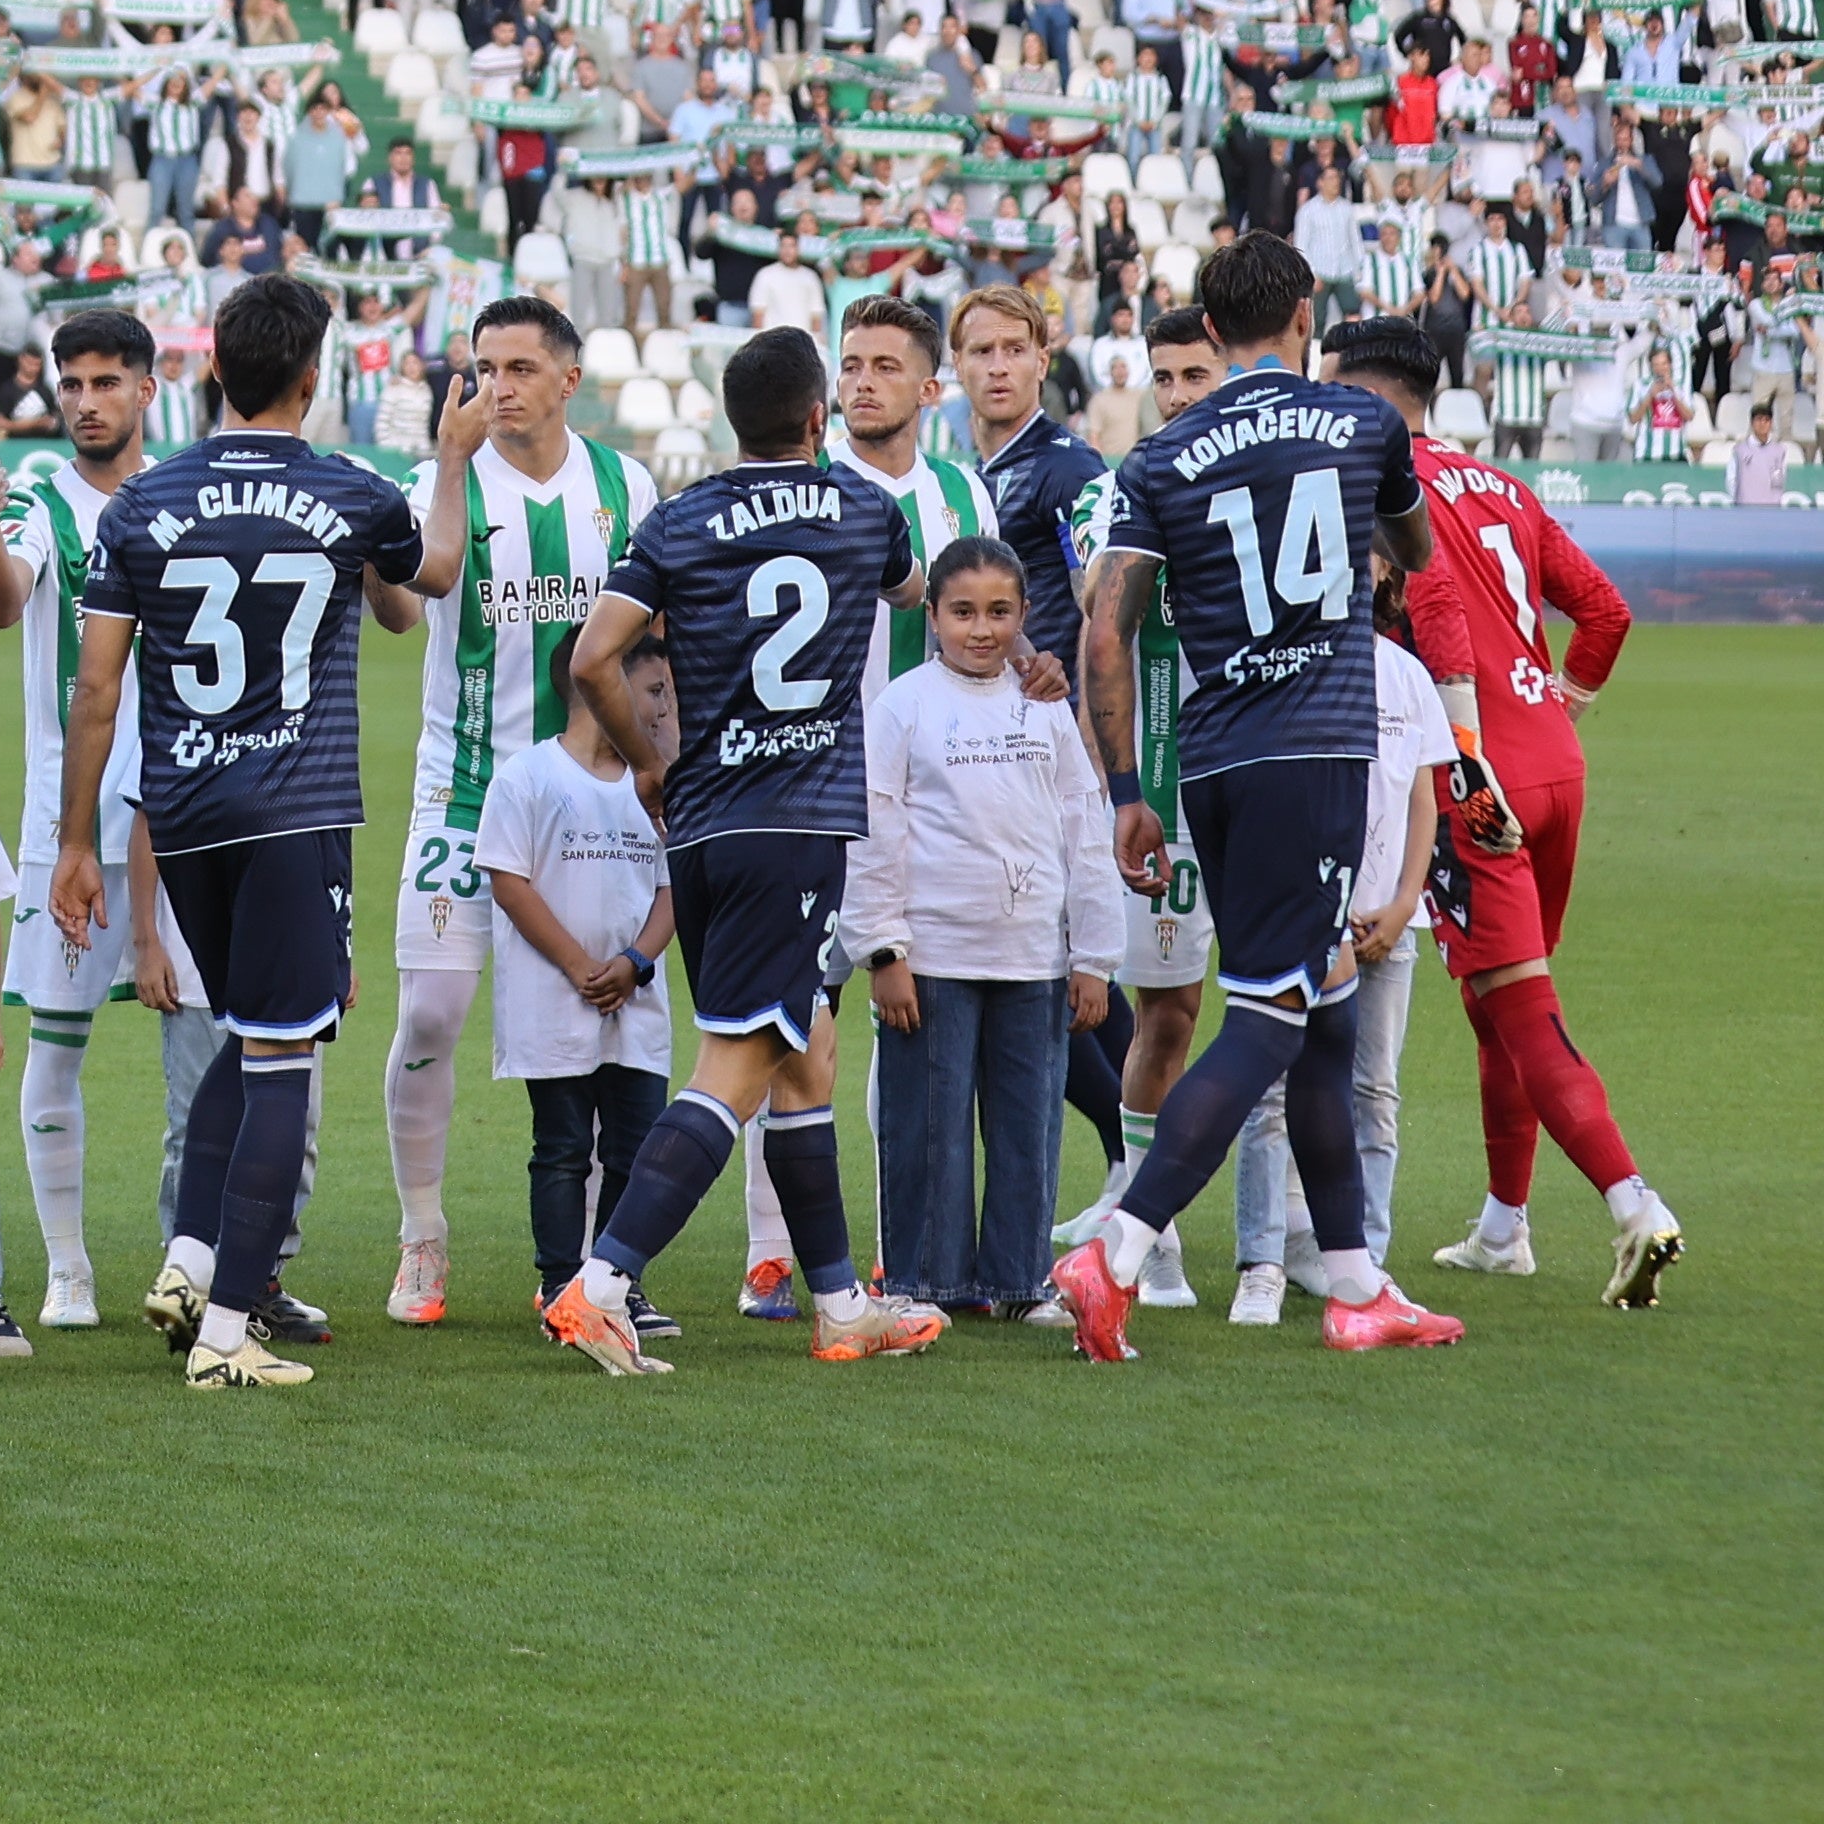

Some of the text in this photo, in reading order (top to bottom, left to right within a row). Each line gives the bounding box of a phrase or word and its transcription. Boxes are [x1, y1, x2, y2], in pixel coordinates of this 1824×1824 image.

[1172, 406, 1359, 483] KOVAČEVIĆ
[147, 481, 353, 553] M. CLIMENT
[706, 484, 842, 541] ZALDUA
[1207, 467, 1354, 639] 14
[1478, 522, 1537, 648] 1
[159, 552, 337, 715] 37
[747, 555, 833, 712] 2
[471, 667, 488, 749] HUMANIDAD
[1149, 668, 1161, 735] PATRIMONIO
[1160, 658, 1172, 740] HUMANIDAD
[945, 751, 1051, 766] SAN RAFAEL MOTOR
[1004, 732, 1027, 741] BMW
[1152, 741, 1164, 789] CÓRDOBA
[414, 835, 482, 899] 23
[561, 849, 627, 861] SAN RAFAEL
